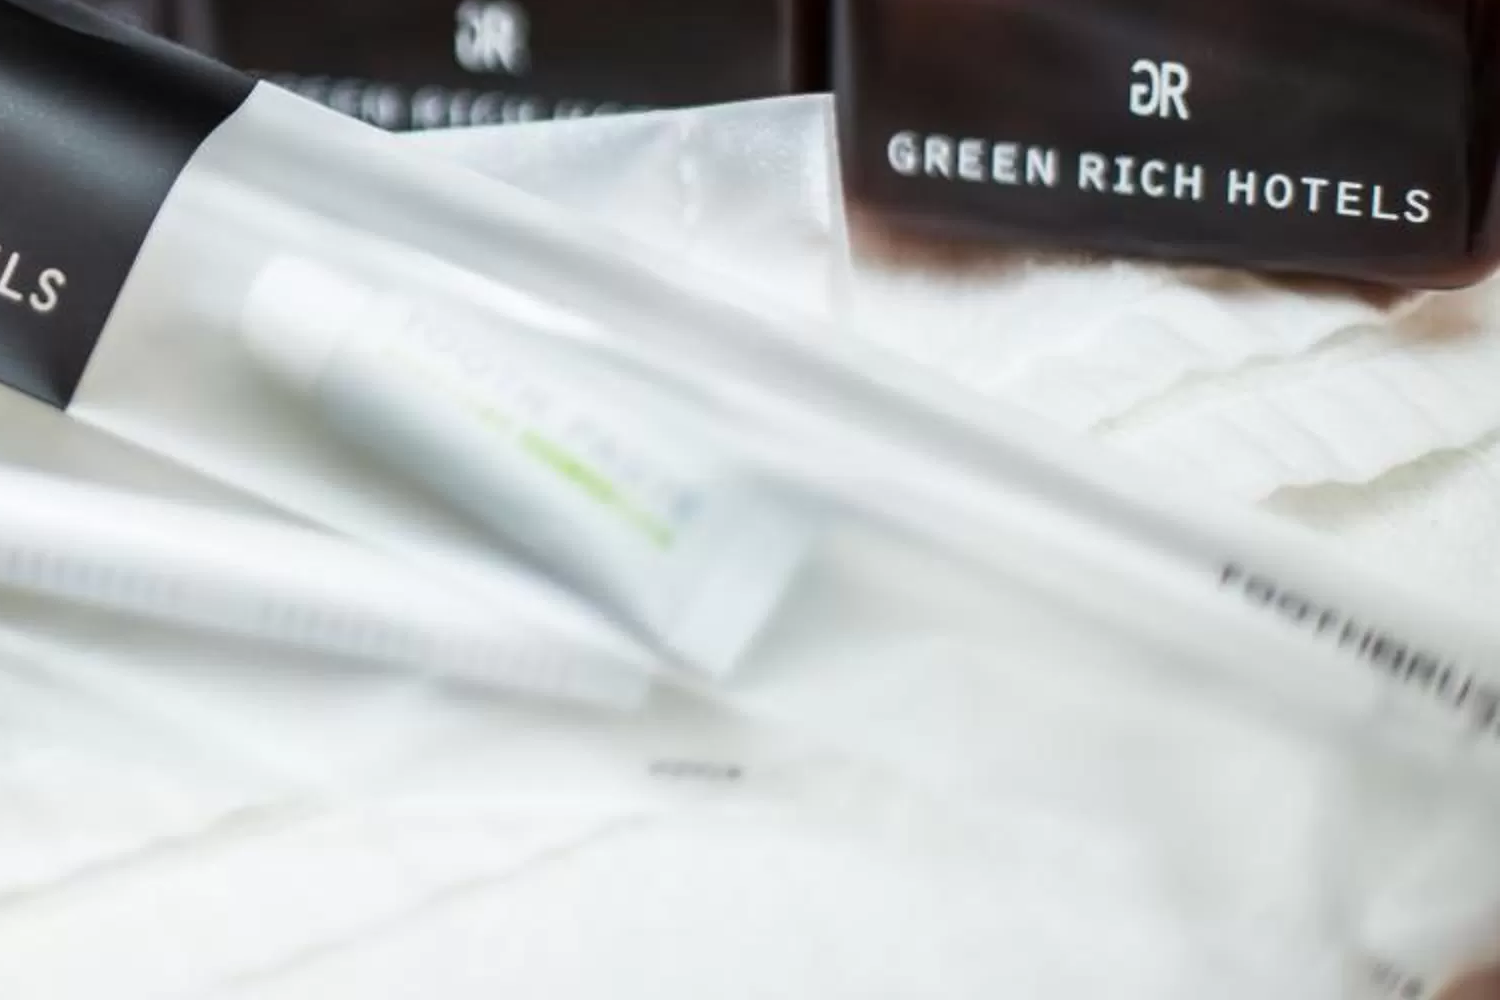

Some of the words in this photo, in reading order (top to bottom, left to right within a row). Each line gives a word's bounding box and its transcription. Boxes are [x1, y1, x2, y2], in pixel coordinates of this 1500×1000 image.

[886, 131, 1059, 186] GREEN
[1077, 152, 1204, 200] RICH
[1226, 168, 1432, 224] HOTELS
